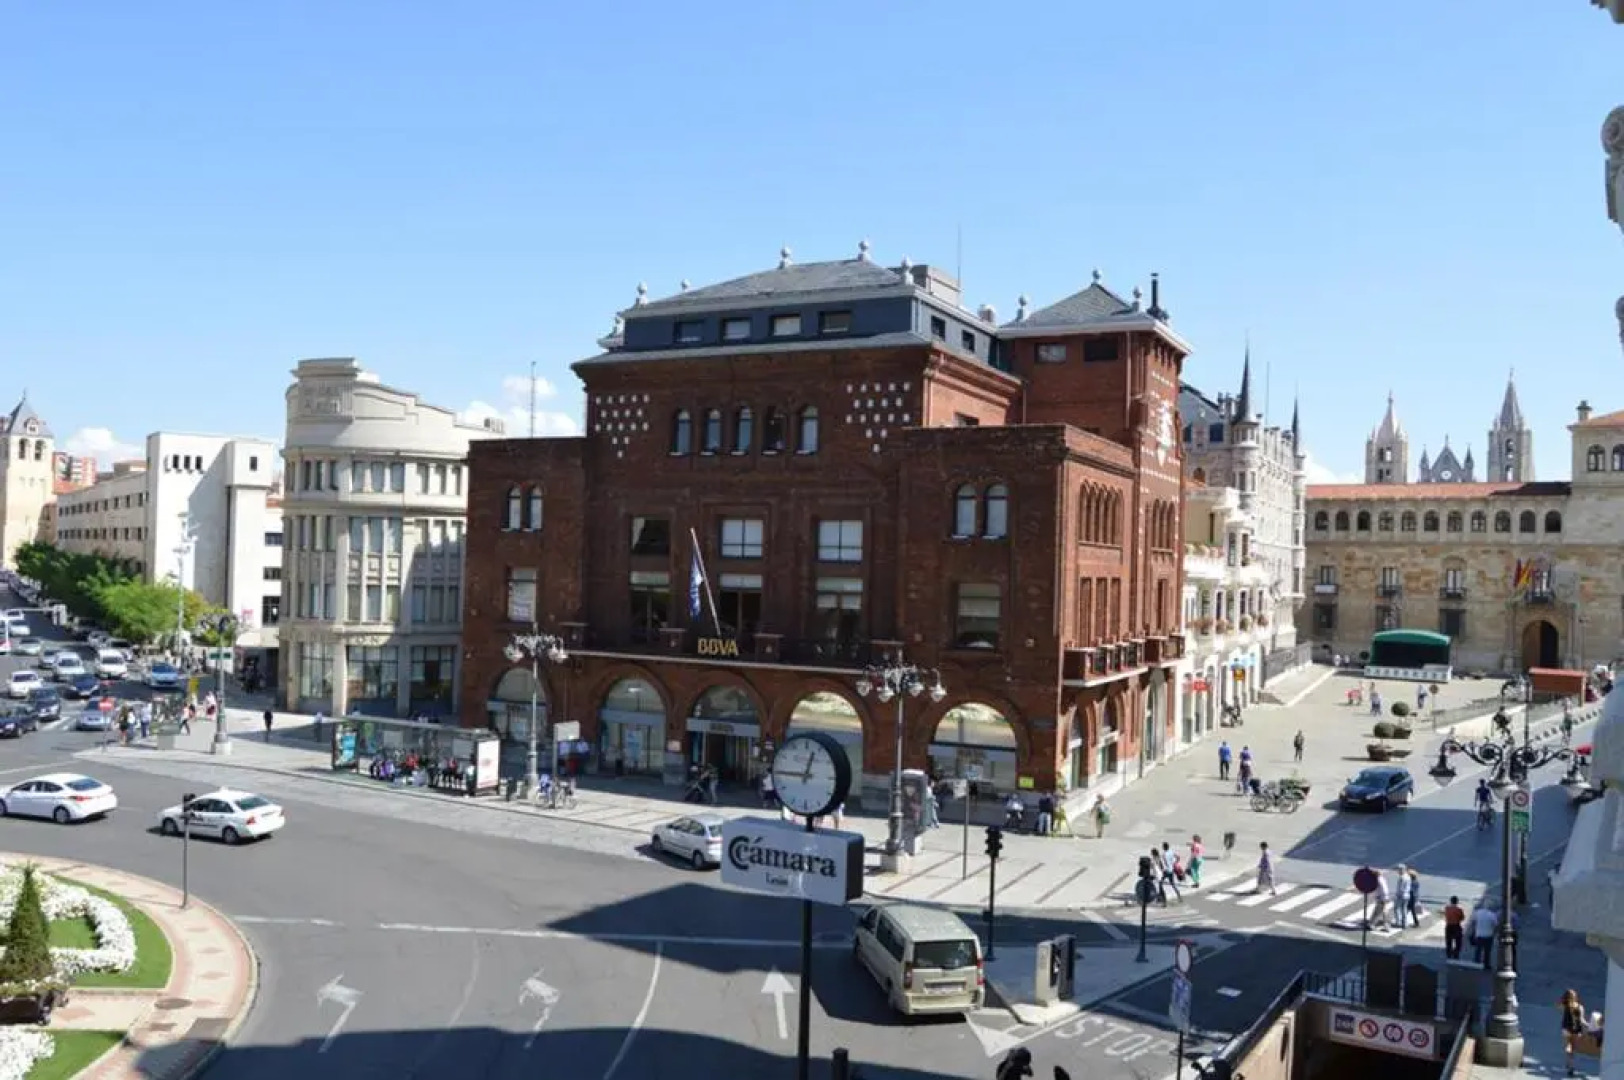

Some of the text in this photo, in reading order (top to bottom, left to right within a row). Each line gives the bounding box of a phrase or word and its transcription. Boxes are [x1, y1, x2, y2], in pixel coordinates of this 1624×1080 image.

[697, 637, 739, 656] BBVA
[728, 835, 837, 878] Cámara
[1054, 1016, 1177, 1062] STOP
